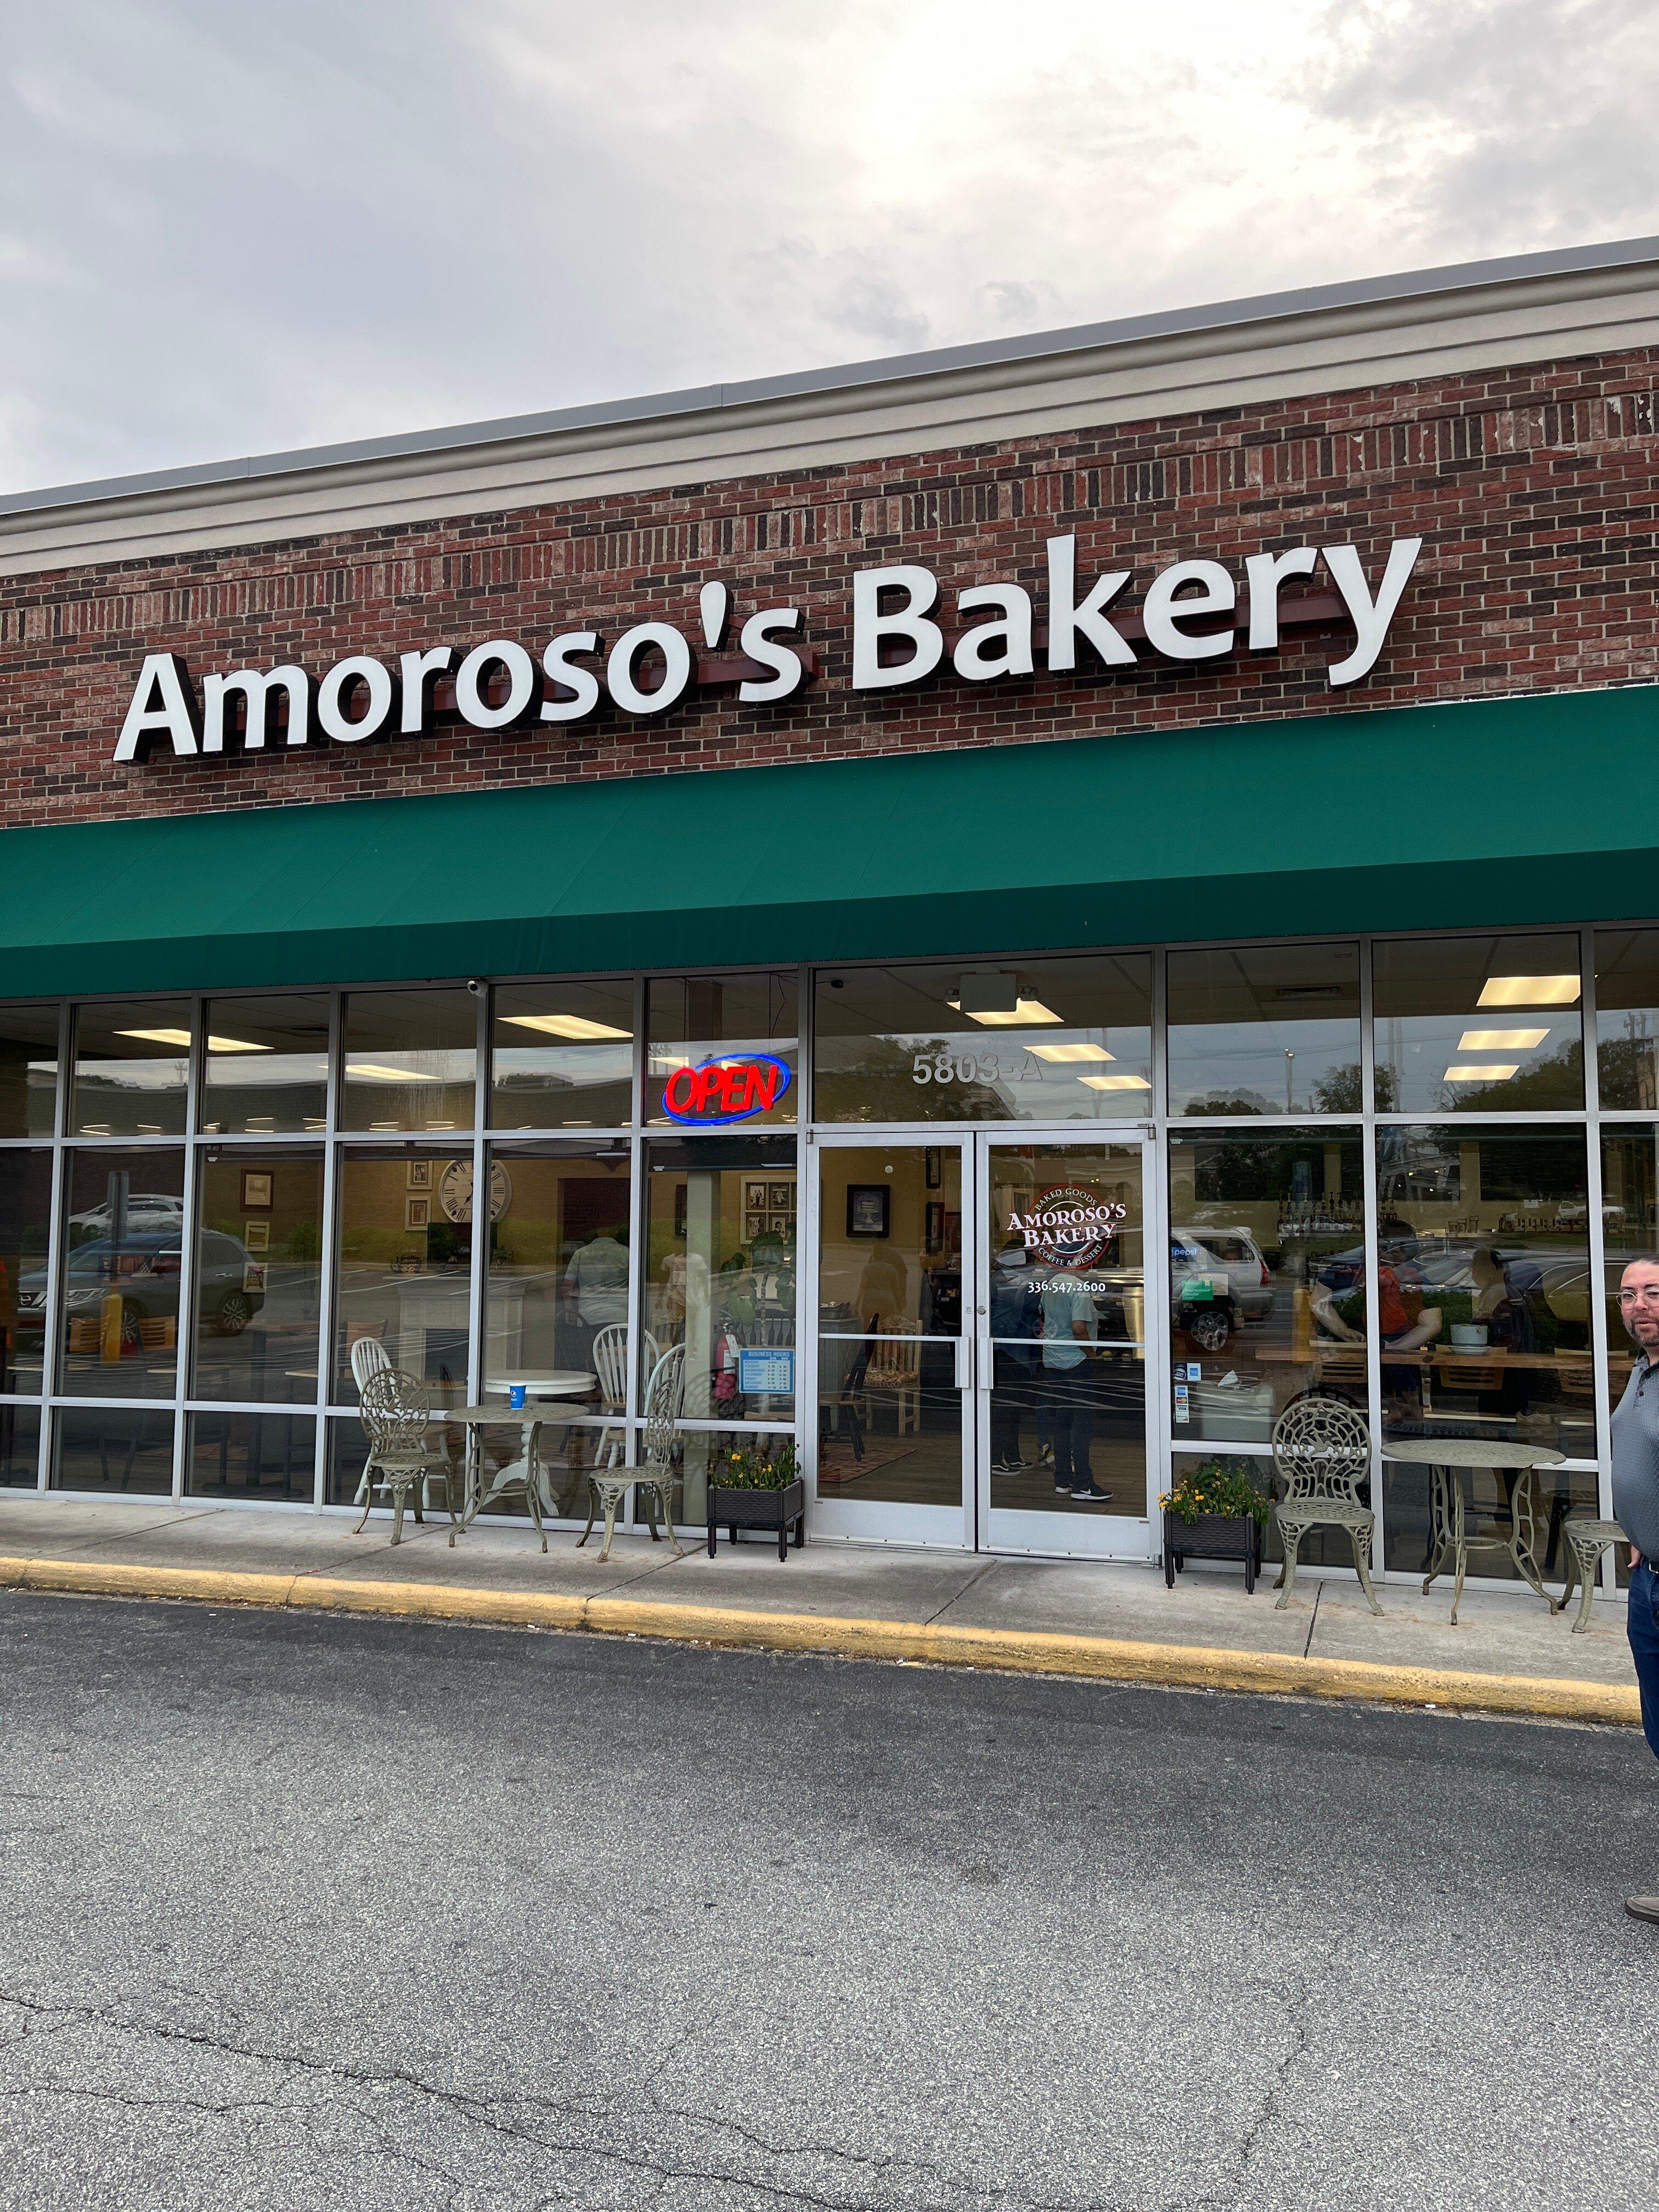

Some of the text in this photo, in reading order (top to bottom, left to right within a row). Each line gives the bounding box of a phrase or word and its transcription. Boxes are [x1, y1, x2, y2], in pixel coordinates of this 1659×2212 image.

[113, 533, 1422, 761] Amoroso's Bakery
[912, 1051, 1042, 1084] 5803-A
[665, 1064, 778, 1112] OPEN
[1034, 1188, 1097, 1211] BAKED GOODS
[1007, 1203, 1126, 1231] AMOROSO'S
[1022, 1223, 1116, 1247] BAKERY
[1039, 1247, 1064, 1266] COFFEE
[1075, 1244, 1103, 1266] DESSERT
[1028, 1280, 1106, 1293] 336.547.2600
